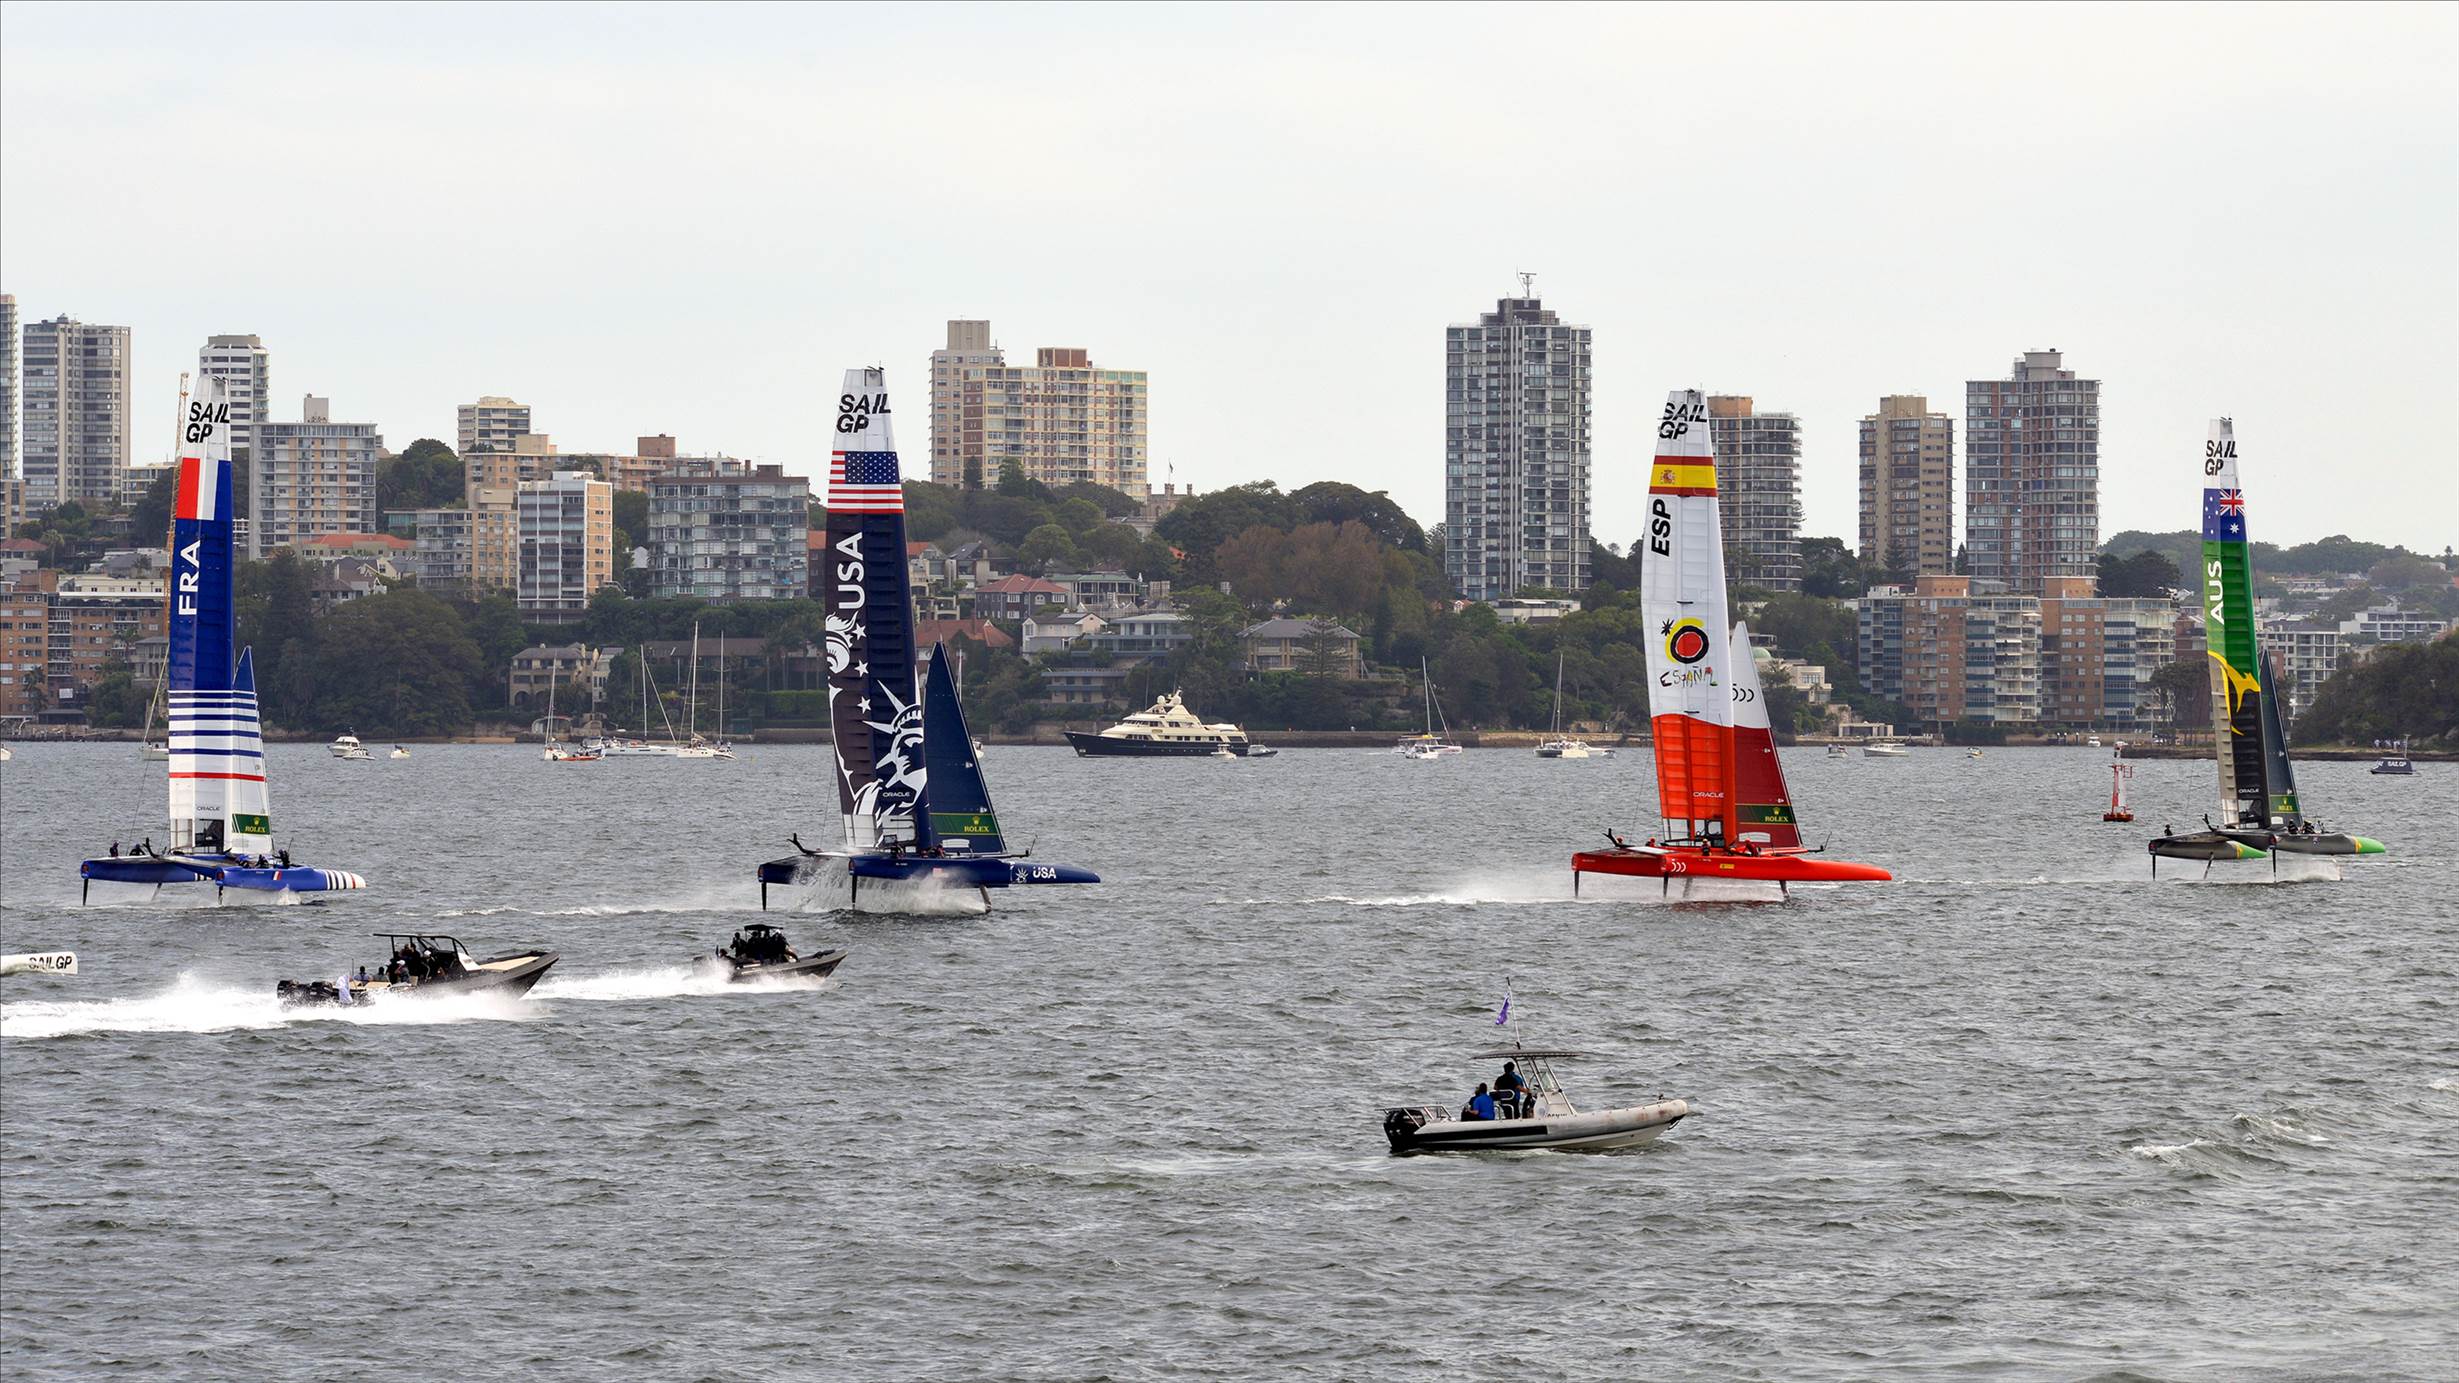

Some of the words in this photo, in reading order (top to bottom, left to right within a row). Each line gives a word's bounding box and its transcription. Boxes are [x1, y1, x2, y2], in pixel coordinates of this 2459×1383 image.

[188, 401, 230, 424] SAIL
[838, 393, 892, 415] SAIL
[1662, 401, 1708, 423] SAIL
[185, 422, 213, 444] GP
[836, 413, 869, 433] GP
[1658, 420, 1689, 440] GP
[2205, 439, 2239, 458] SAIL
[2204, 457, 2224, 476] GP
[1651, 498, 1671, 557] ESP
[178, 539, 201, 616] FRA
[835, 531, 866, 610] USA
[2207, 560, 2225, 626] AUS
[882, 790, 911, 799] ORACLE
[1692, 791, 1725, 799] ORACLE
[244, 824, 267, 834] ROLEX
[963, 824, 990, 833] ROLEX
[1764, 815, 1789, 823] ROLEX
[1031, 865, 1058, 880] USA
